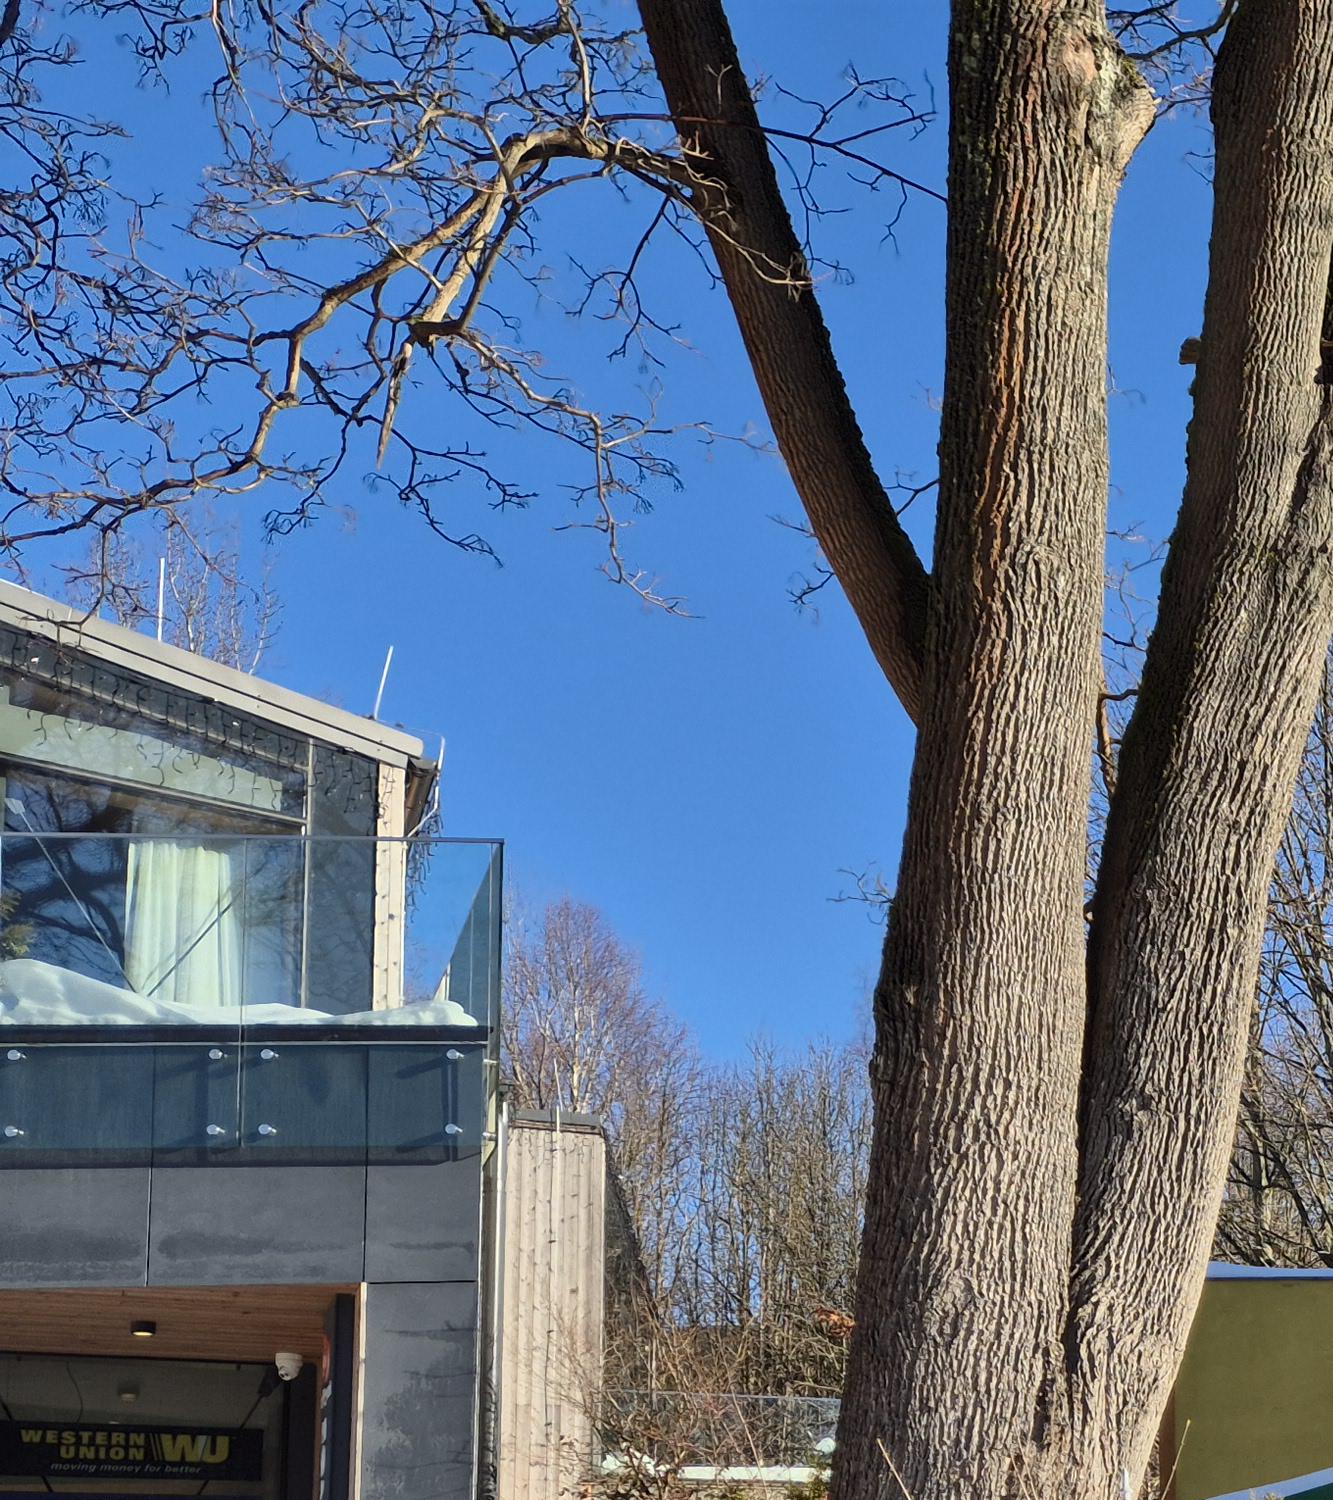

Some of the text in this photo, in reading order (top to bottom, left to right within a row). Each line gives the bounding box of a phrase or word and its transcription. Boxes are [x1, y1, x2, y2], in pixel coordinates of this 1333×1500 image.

[20, 1429, 147, 1447] WESTERN
[59, 1446, 147, 1461] UNION
[160, 1433, 232, 1464] WU
[50, 1461, 202, 1474] moving money for better
